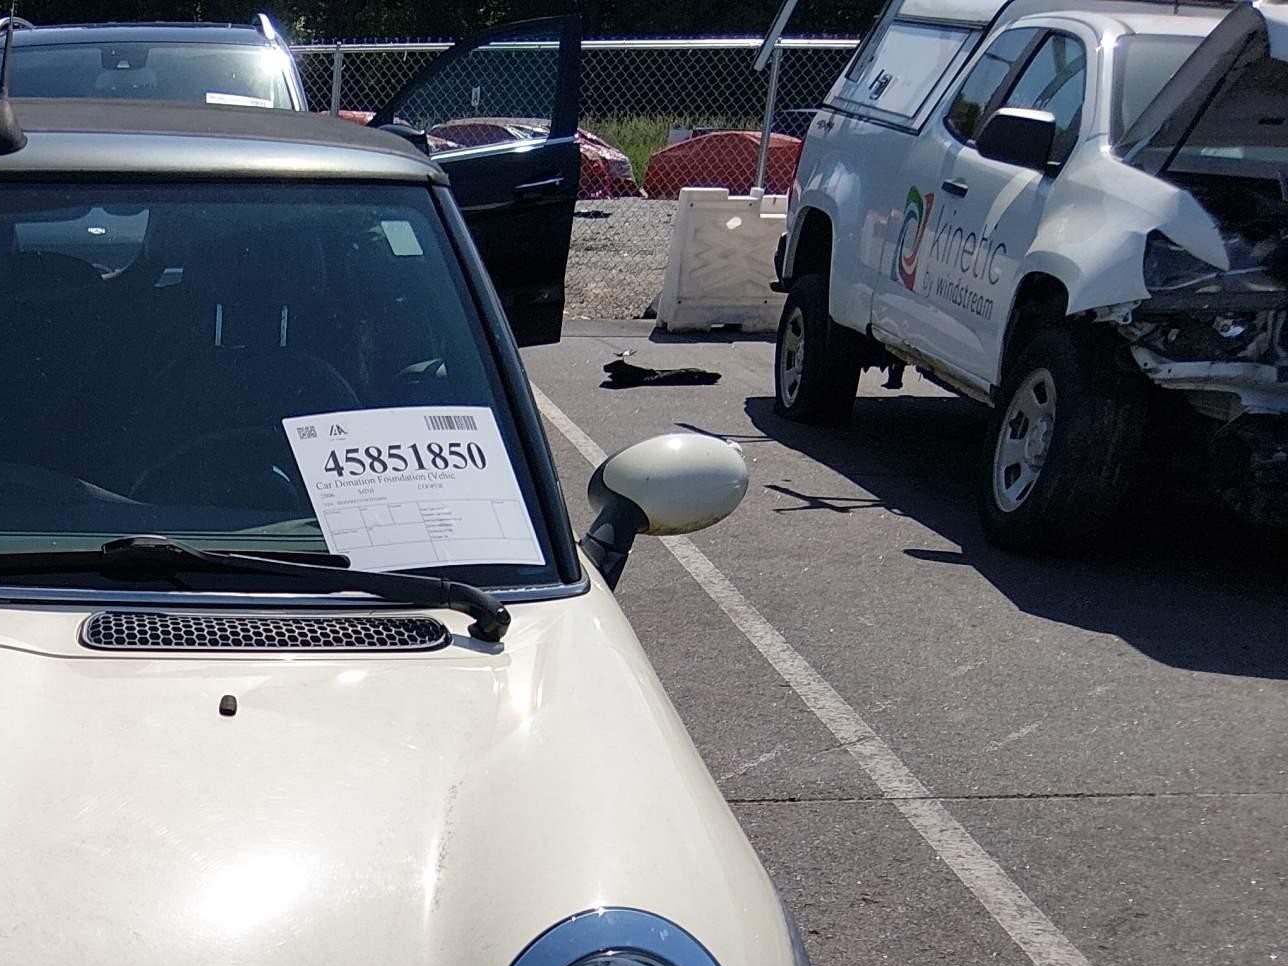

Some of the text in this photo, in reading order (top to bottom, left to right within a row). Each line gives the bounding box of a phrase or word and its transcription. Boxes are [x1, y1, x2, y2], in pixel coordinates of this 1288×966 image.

[929, 204, 1007, 286] kinetic
[936, 272, 994, 321] windstream
[324, 441, 487, 477] 45851850
[316, 481, 332, 490] Car
[335, 476, 376, 489] Donation
[377, 473, 427, 484] Foundation
